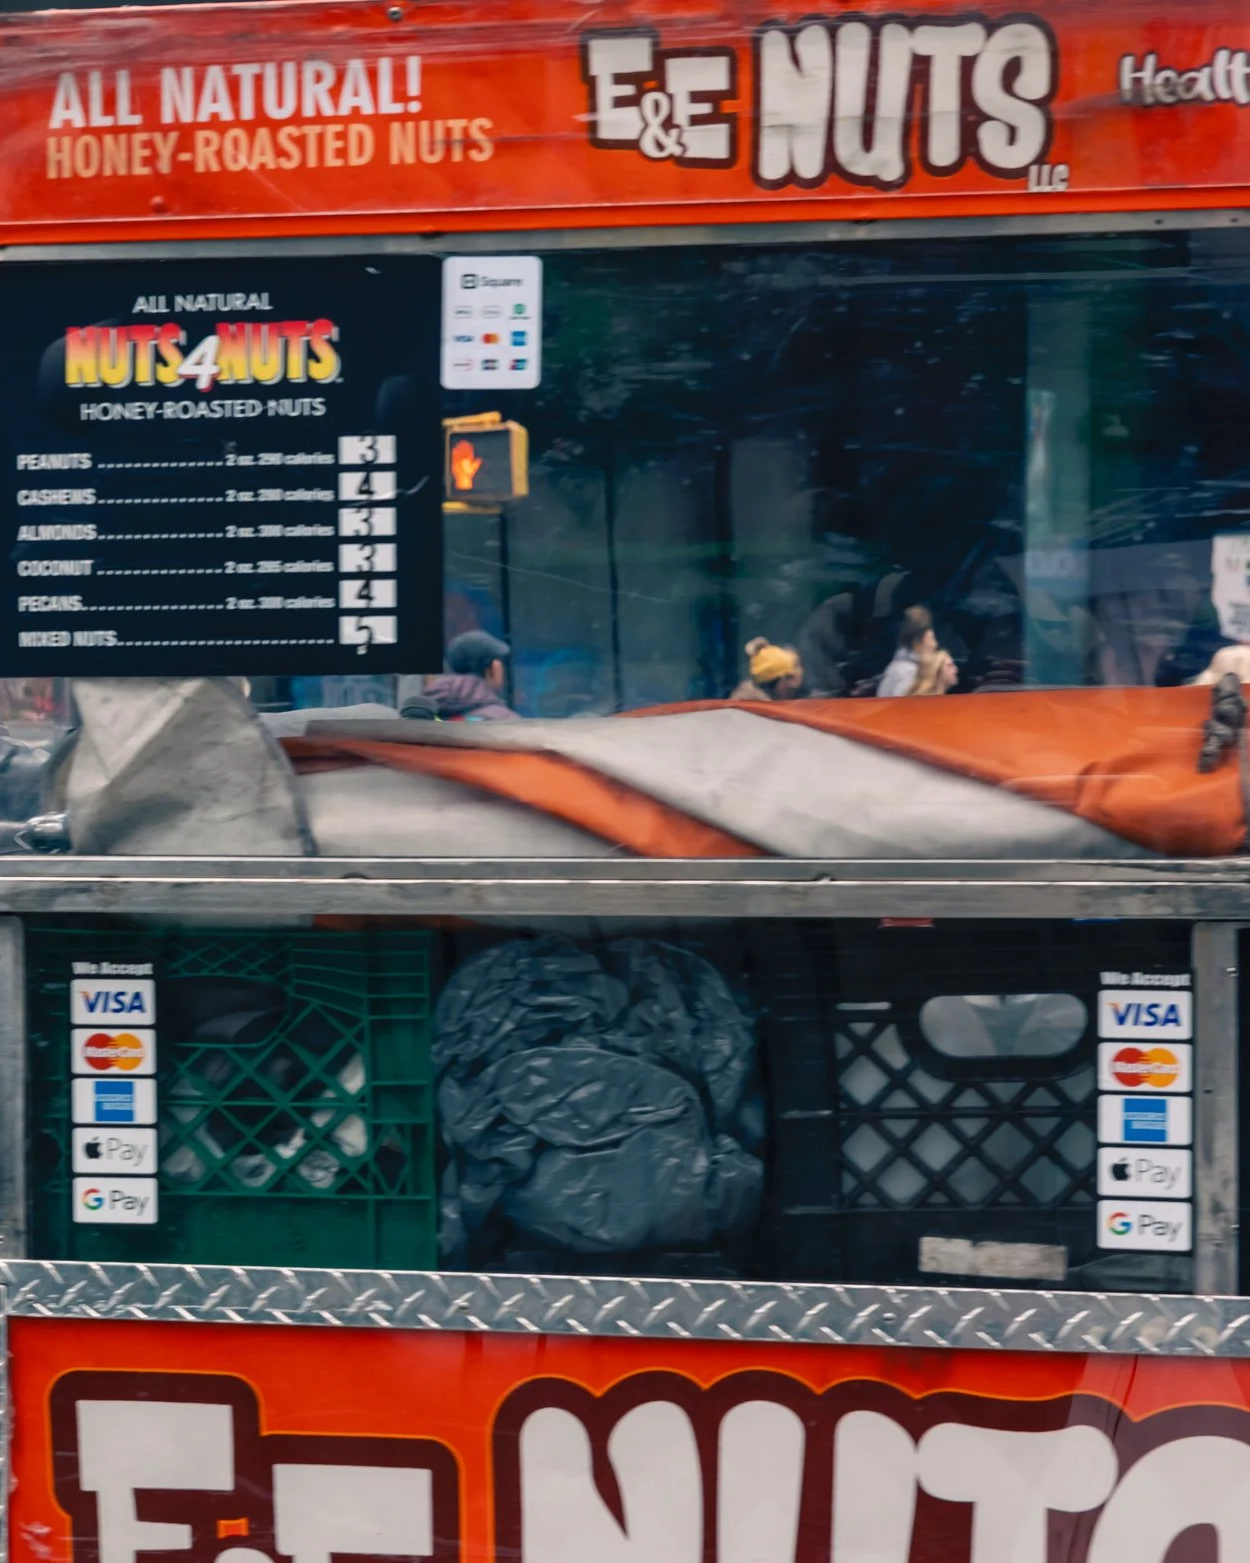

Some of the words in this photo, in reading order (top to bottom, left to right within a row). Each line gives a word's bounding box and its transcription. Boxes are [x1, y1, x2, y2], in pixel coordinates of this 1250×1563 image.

[50, 69, 142, 129] ALL
[160, 56, 422, 123] NATURAL!
[588, 37, 731, 160] E&E
[758, 20, 1052, 182] NUTS
[46, 121, 375, 179] HONEY-ROASTED
[389, 117, 495, 165] NUTS
[1027, 163, 1069, 193] LLC
[132, 295, 170, 313] ALL
[174, 292, 274, 312] NATURAL
[79, 398, 263, 421] HONEY-ROASTED
[266, 396, 327, 417] NUTS
[358, 435, 378, 464] 3
[357, 471, 375, 500] 4
[353, 507, 373, 536] 3
[356, 543, 376, 572] 3
[356, 579, 375, 608] 4
[356, 615, 374, 655] 5
[71, 962, 98, 974] We
[99, 962, 154, 976] Accept
[1099, 971, 1130, 985] We
[1130, 972, 1191, 987] Accept
[78, 991, 146, 1014] VISA
[1106, 1003, 1182, 1026] VISA
[105, 1137, 150, 1168] Pay
[1134, 1158, 1183, 1190] Pay
[109, 1189, 151, 1216] Pay
[1137, 1214, 1184, 1243] Pay
